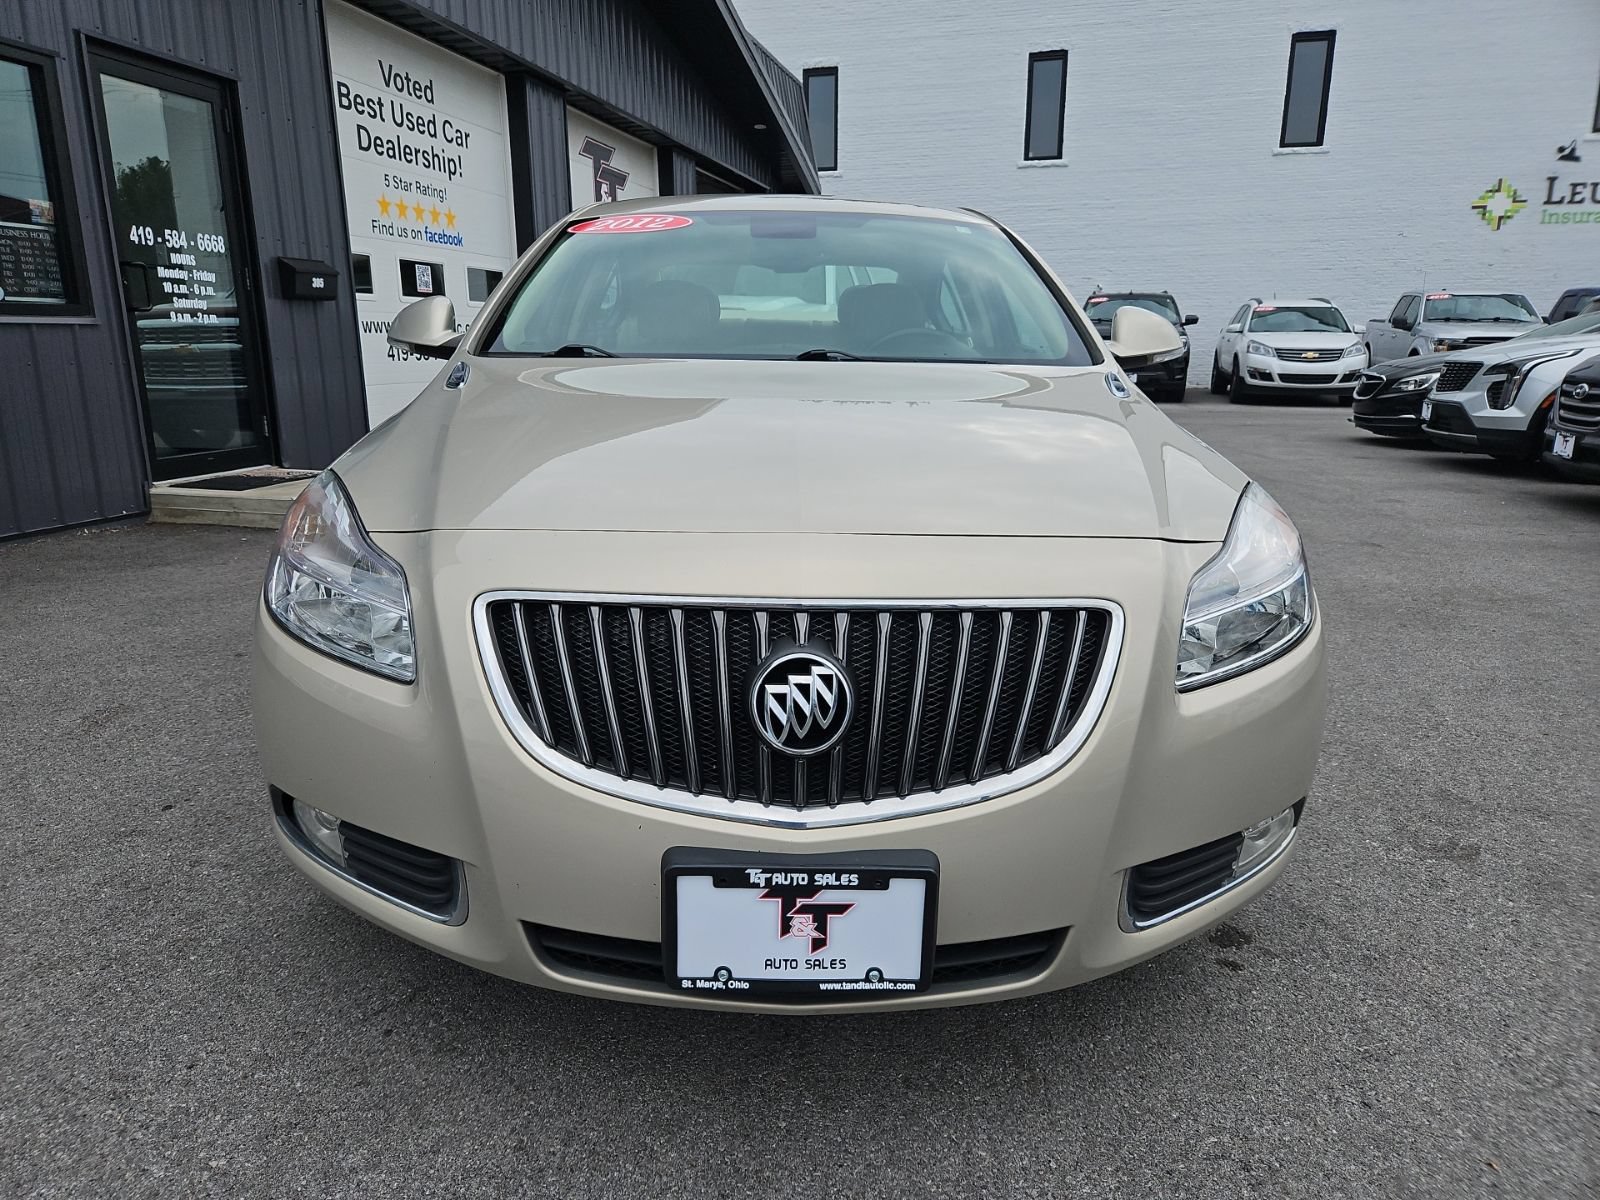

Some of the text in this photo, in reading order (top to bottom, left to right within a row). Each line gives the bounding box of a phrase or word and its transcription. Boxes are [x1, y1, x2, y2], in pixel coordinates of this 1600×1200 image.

[378, 59, 434, 104] Voted
[337, 80, 471, 149] Best Used Car
[356, 124, 463, 181] Dealership!
[384, 173, 447, 203] 5 Star Rating!
[584, 216, 675, 231] 2012
[130, 225, 154, 246] 419
[164, 229, 188, 249] 584
[197, 232, 225, 253] 6668
[371, 219, 463, 247] Find us on facebook
[170, 252, 196, 266] HOURS
[157, 266, 188, 280] Monday
[193, 269, 216, 283] Friday
[163, 282, 172, 293] 10
[194, 284, 199, 295] 6
[201, 286, 216, 296] p.m.
[173, 296, 207, 310] Saturday
[170, 311, 176, 323] 9
[197, 312, 203, 323] 2
[772, 872, 808, 886] AUTO
[814, 872, 859, 886] SALES
[765, 958, 847, 971] AUTO SALES
[681, 979, 750, 990] St. Marys, Ohio
[819, 981, 916, 990] www.tandtautollc.com
